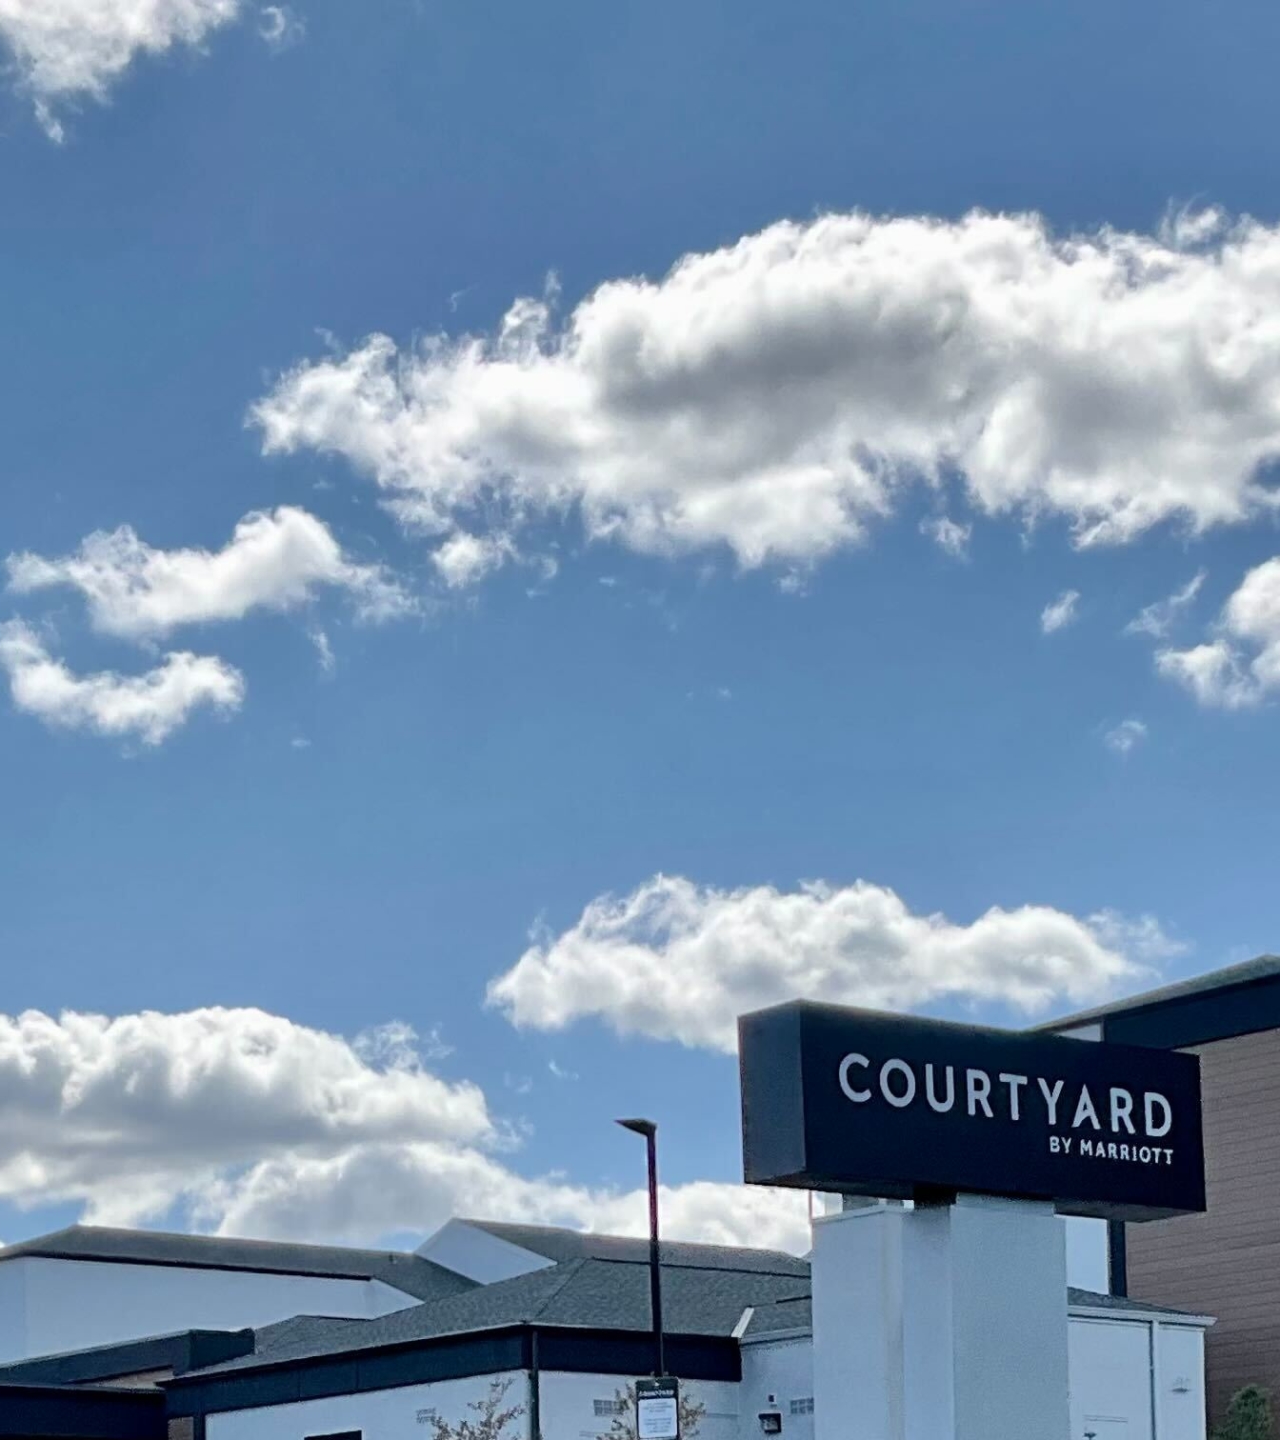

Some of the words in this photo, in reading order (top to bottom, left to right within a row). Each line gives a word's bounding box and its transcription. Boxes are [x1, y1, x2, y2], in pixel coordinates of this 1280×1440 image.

[838, 1051, 1174, 1138] COURTYARD
[1049, 1135, 1073, 1154] BY
[1080, 1139, 1175, 1166] MARRIOTT
